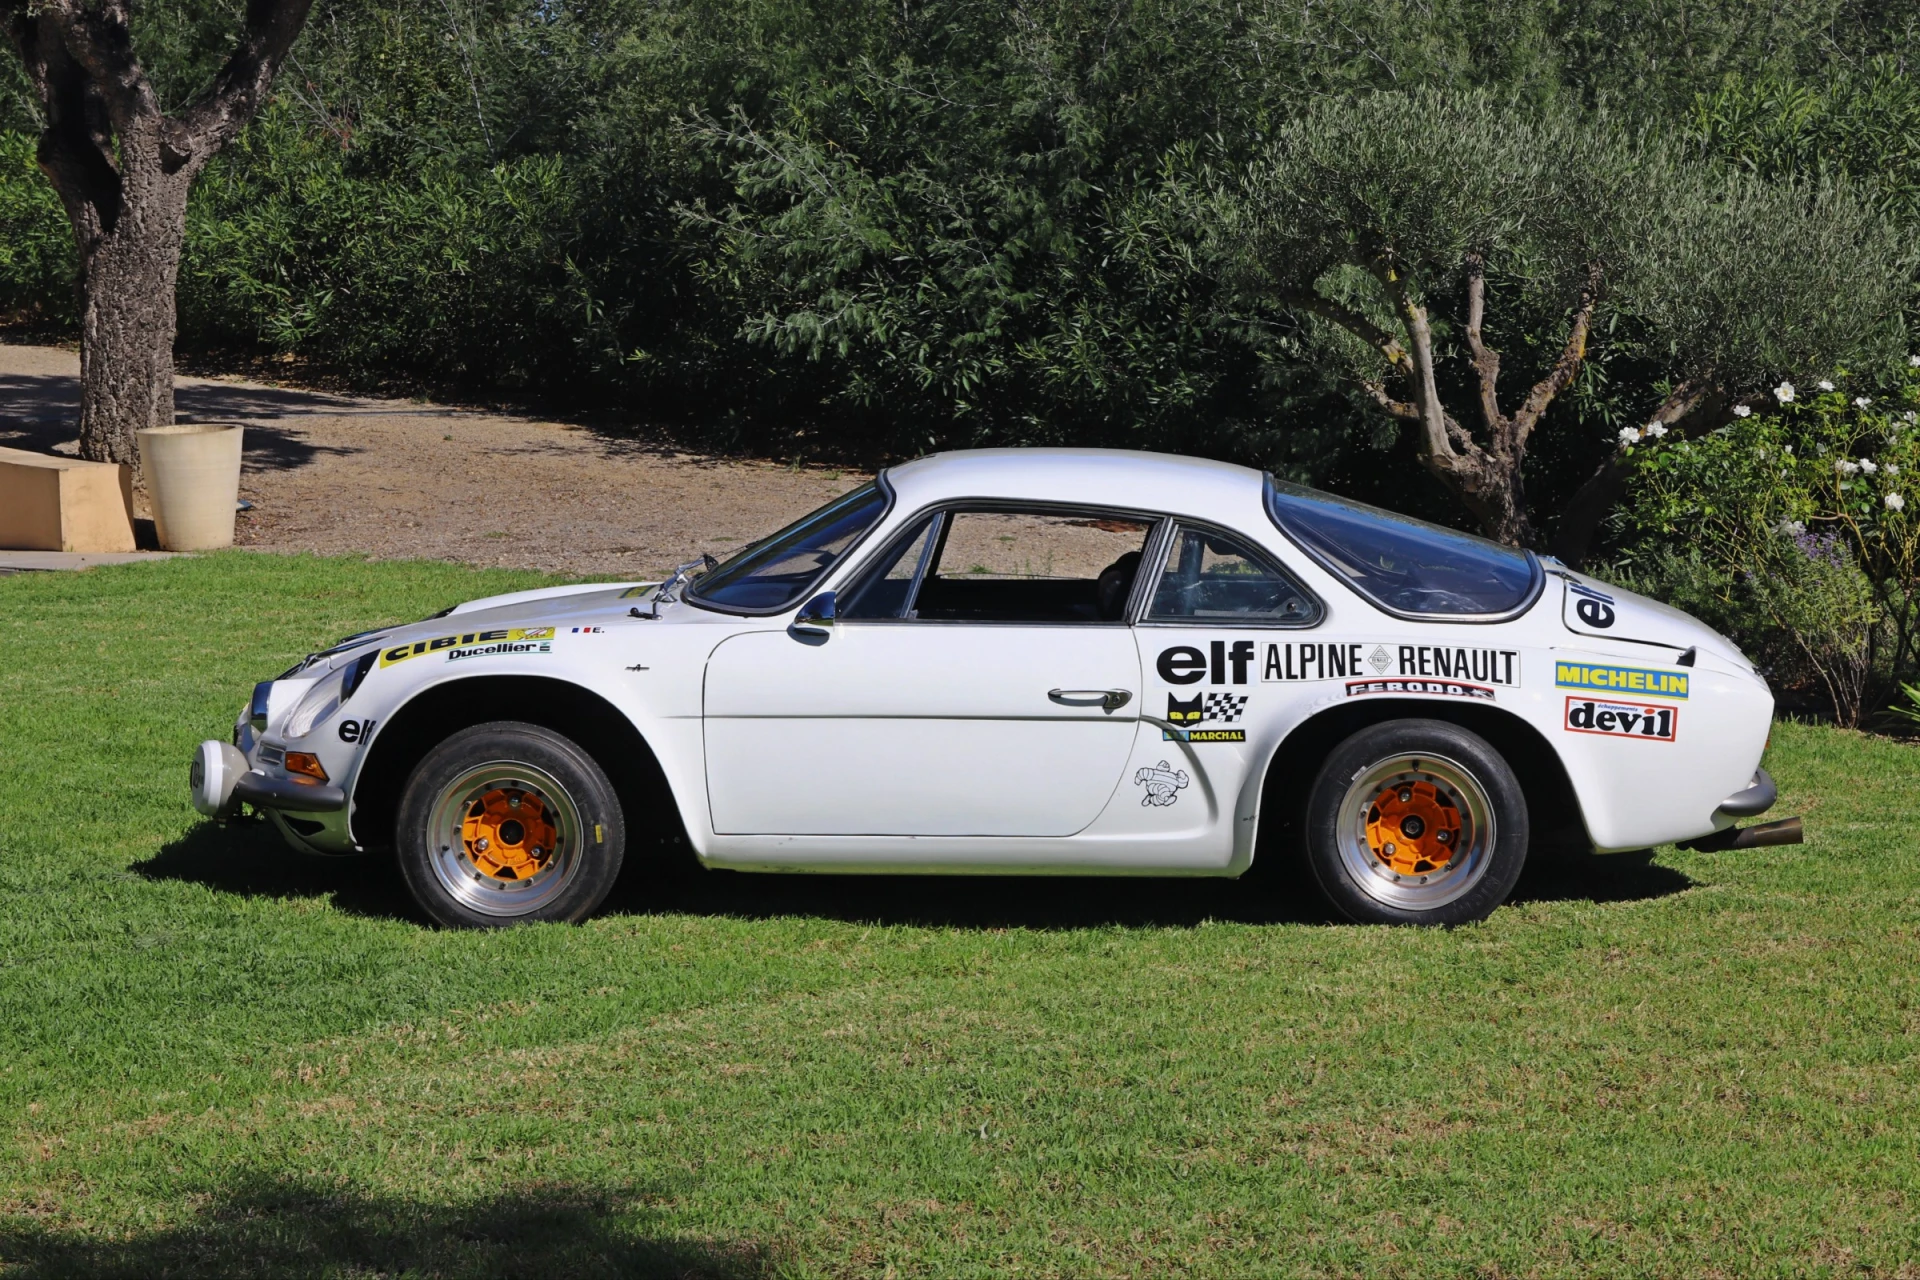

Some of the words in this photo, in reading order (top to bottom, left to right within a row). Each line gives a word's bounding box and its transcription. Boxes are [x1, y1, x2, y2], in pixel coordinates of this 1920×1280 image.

[1569, 582, 1615, 629] elf
[385, 629, 509, 662] CIBIE
[448, 643, 537, 660] Ducellier
[1156, 640, 1254, 685] elf
[1264, 643, 1363, 681] ALPINE
[1398, 645, 1518, 685] RENAULT
[1350, 682, 1464, 696] FERODO
[1557, 665, 1688, 695] MICHELIN
[338, 719, 377, 746] elf
[1569, 702, 1671, 737] devil
[1189, 731, 1244, 740] MARCHAL
